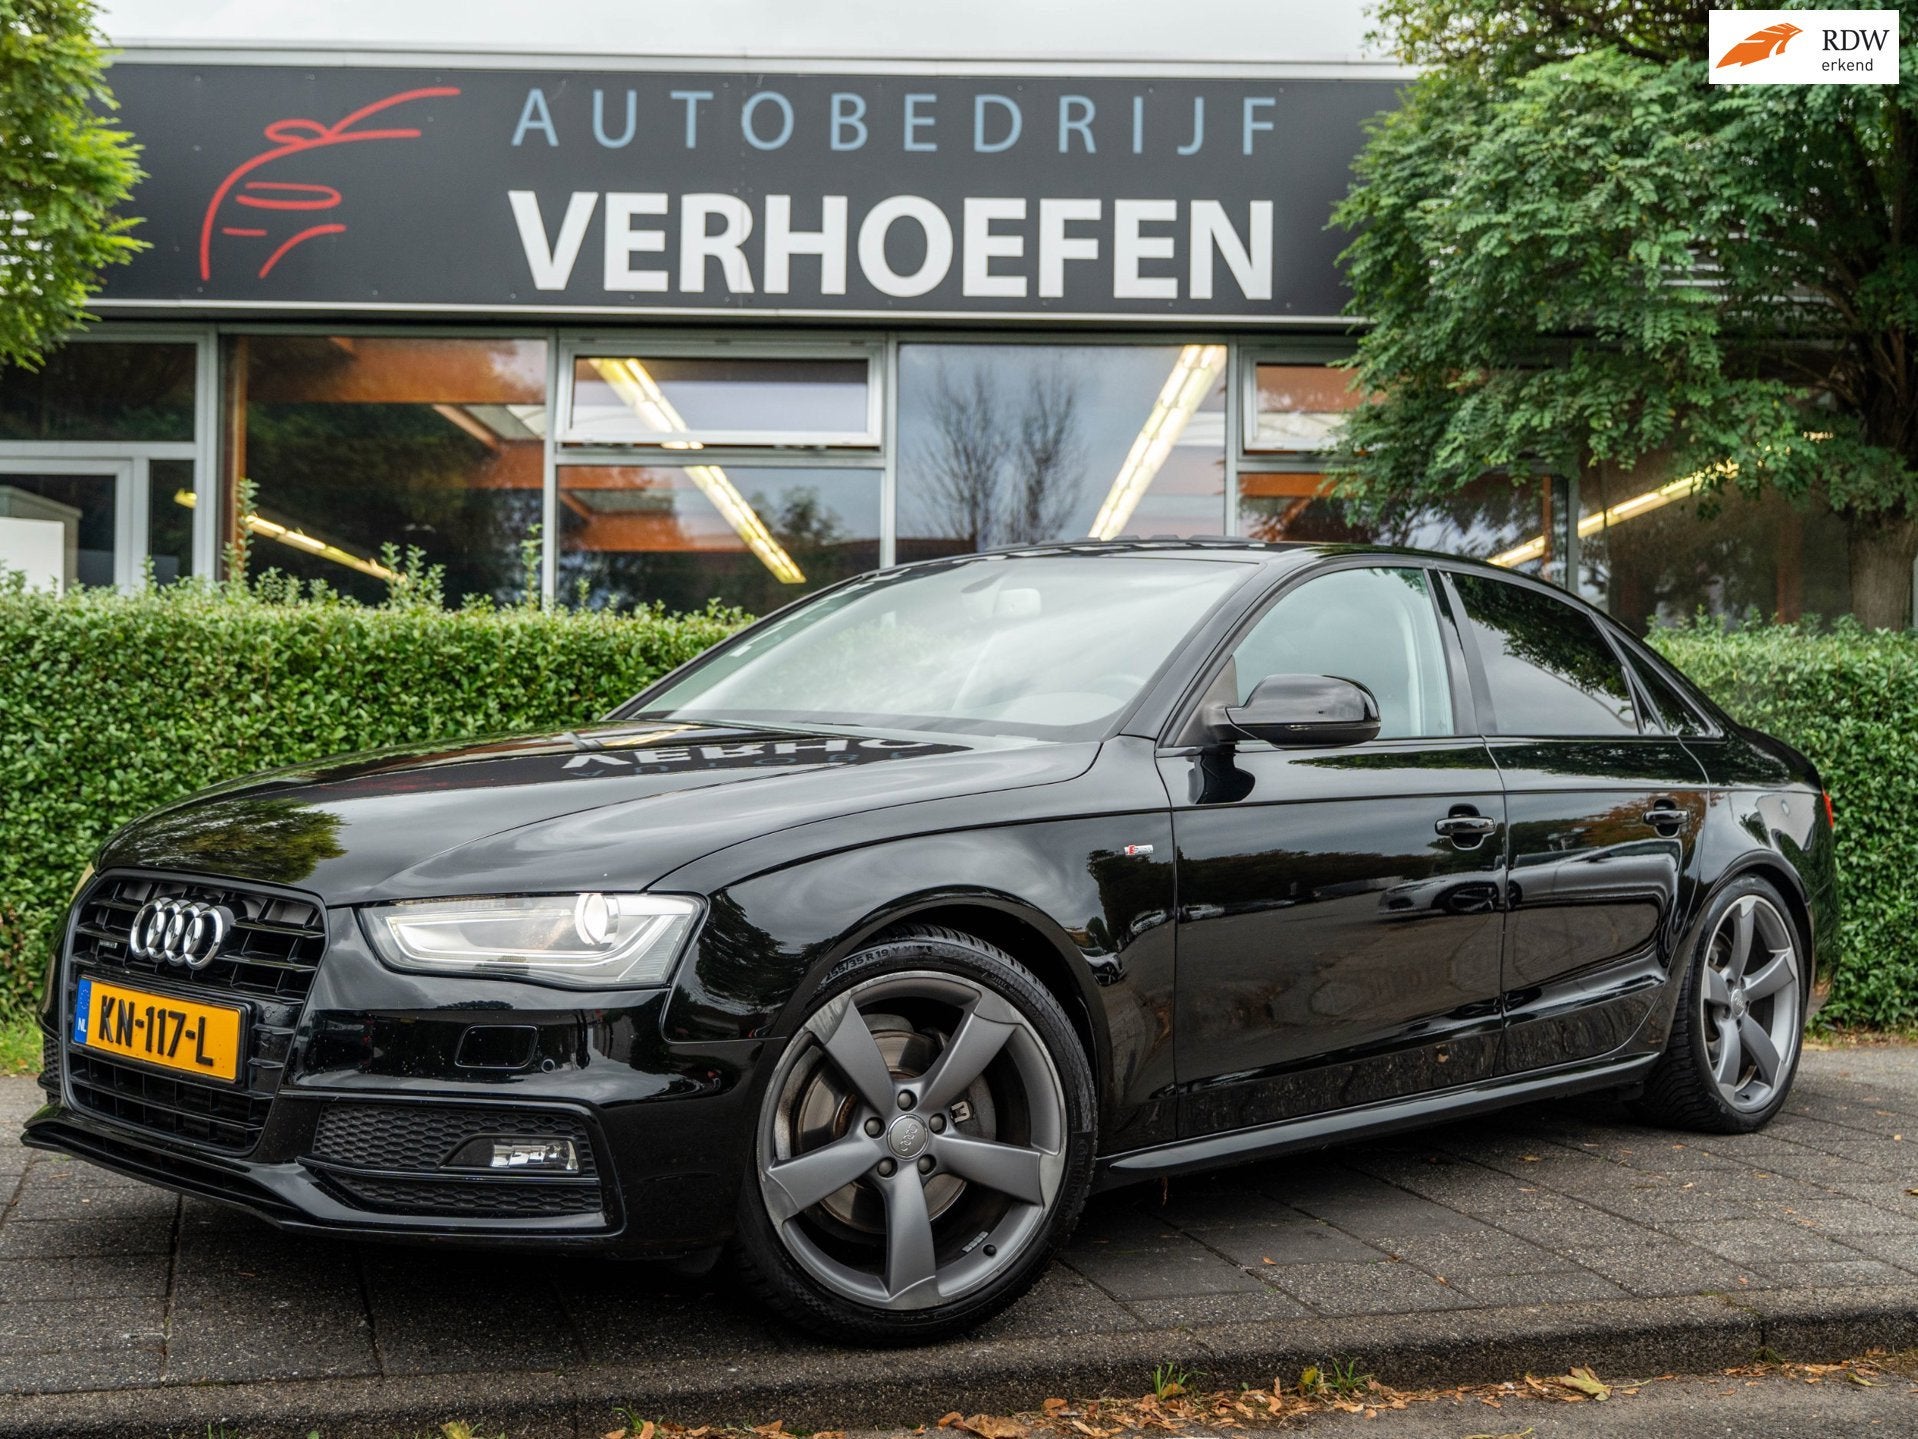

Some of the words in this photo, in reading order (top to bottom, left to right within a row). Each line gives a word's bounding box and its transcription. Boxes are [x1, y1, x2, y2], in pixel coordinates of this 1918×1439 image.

[512, 88, 1276, 156] AUTOBEDRIJF
[508, 189, 1274, 301] VERHOEFEN
[77, 1017, 87, 1033] NL
[98, 994, 214, 1067] KN-117-L
